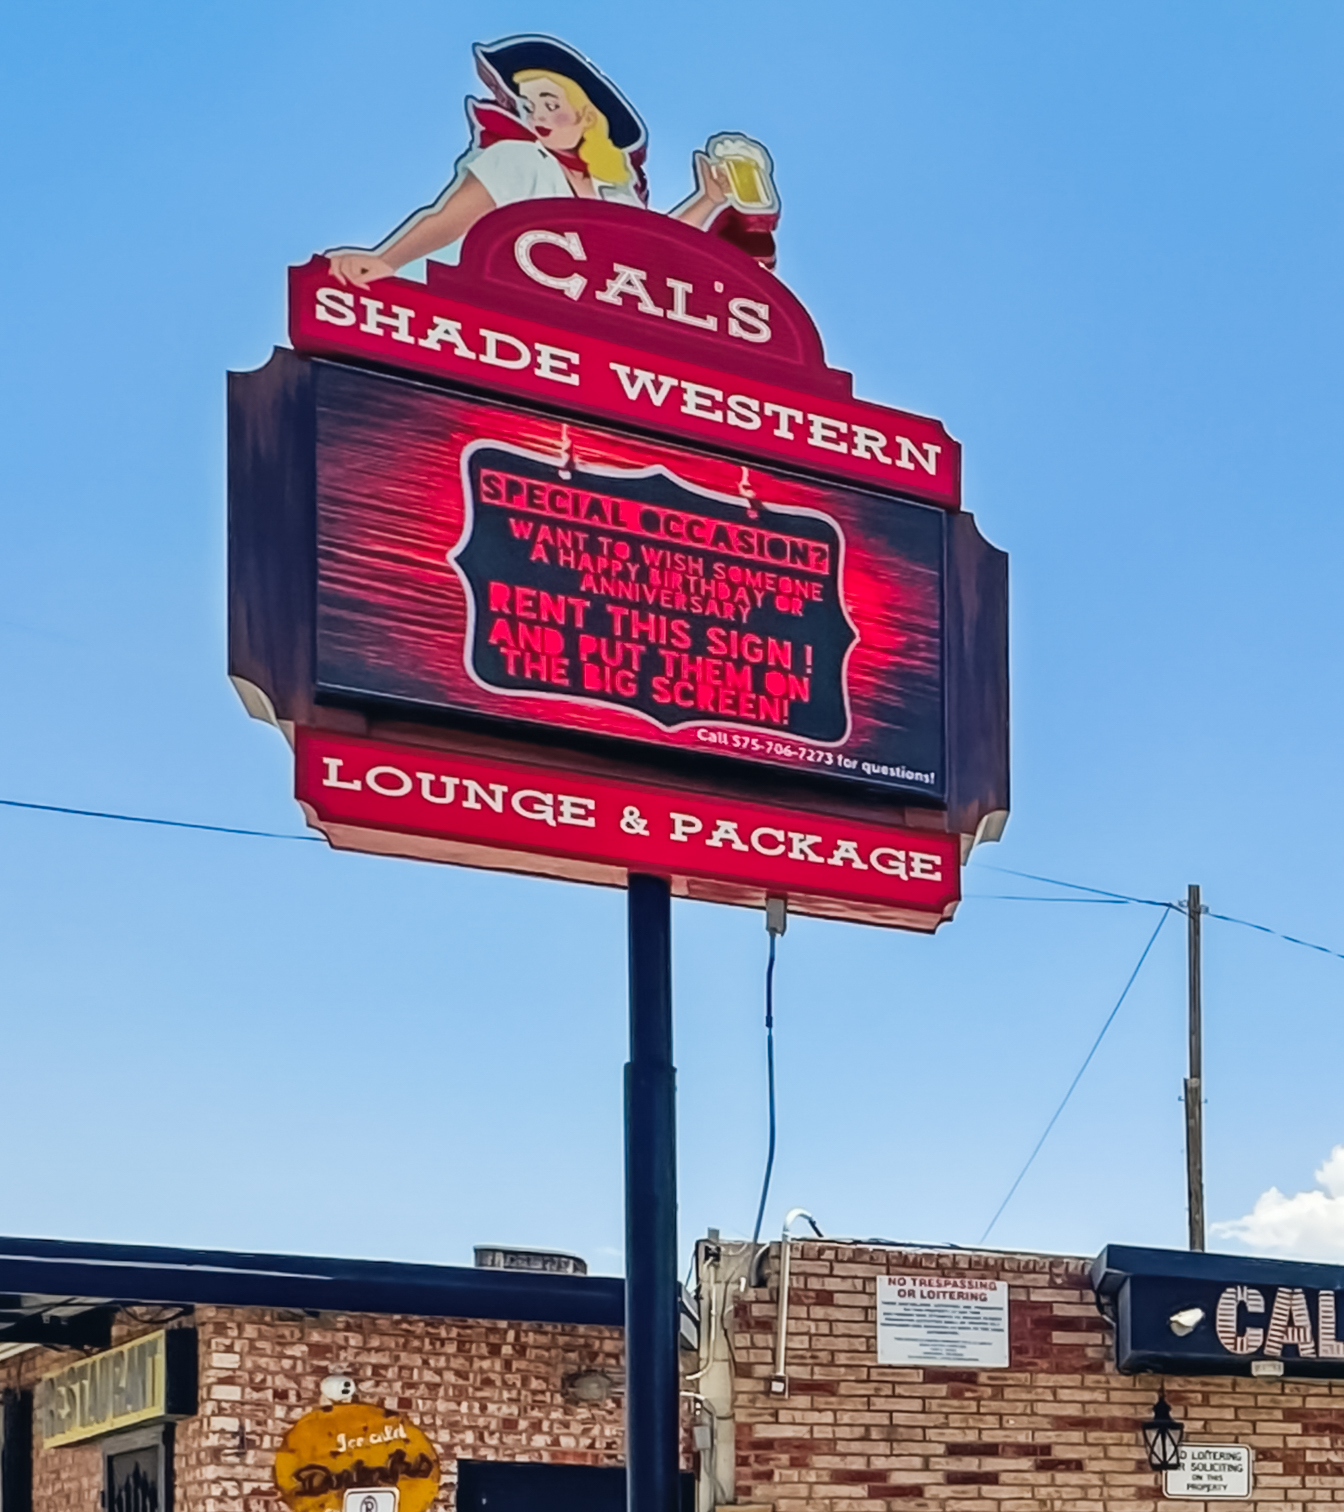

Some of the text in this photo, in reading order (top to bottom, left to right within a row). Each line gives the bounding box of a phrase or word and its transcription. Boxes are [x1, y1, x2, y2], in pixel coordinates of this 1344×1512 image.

[514, 229, 771, 343] CAL'S
[314, 287, 942, 476] SHADE WESTERN
[481, 473, 830, 571] SPECIAL OCCASION?
[509, 517, 824, 603] WANT TO WISH SOMEONE
[529, 543, 804, 617] A HAPPY BIRTHDAY OR
[580, 572, 752, 624] ANNIVERSARY
[488, 581, 592, 629] RENT
[605, 603, 692, 650] THIS
[706, 627, 794, 671] SIGN
[488, 618, 811, 704] AND PUT THEM ON
[501, 648, 790, 726] THE BIG SCREEN!
[696, 728, 729, 748] Call
[837, 754, 859, 771] for
[861, 761, 936, 786] questions!
[322, 756, 943, 883] LOUNGE & PACKAGE
[888, 1277, 998, 1291] NO TRESPASSING
[897, 1289, 988, 1302] OR LOITERING
[1191, 1450, 1242, 1462] LOITERING
[1191, 1462, 1244, 1473] SOLICITING
